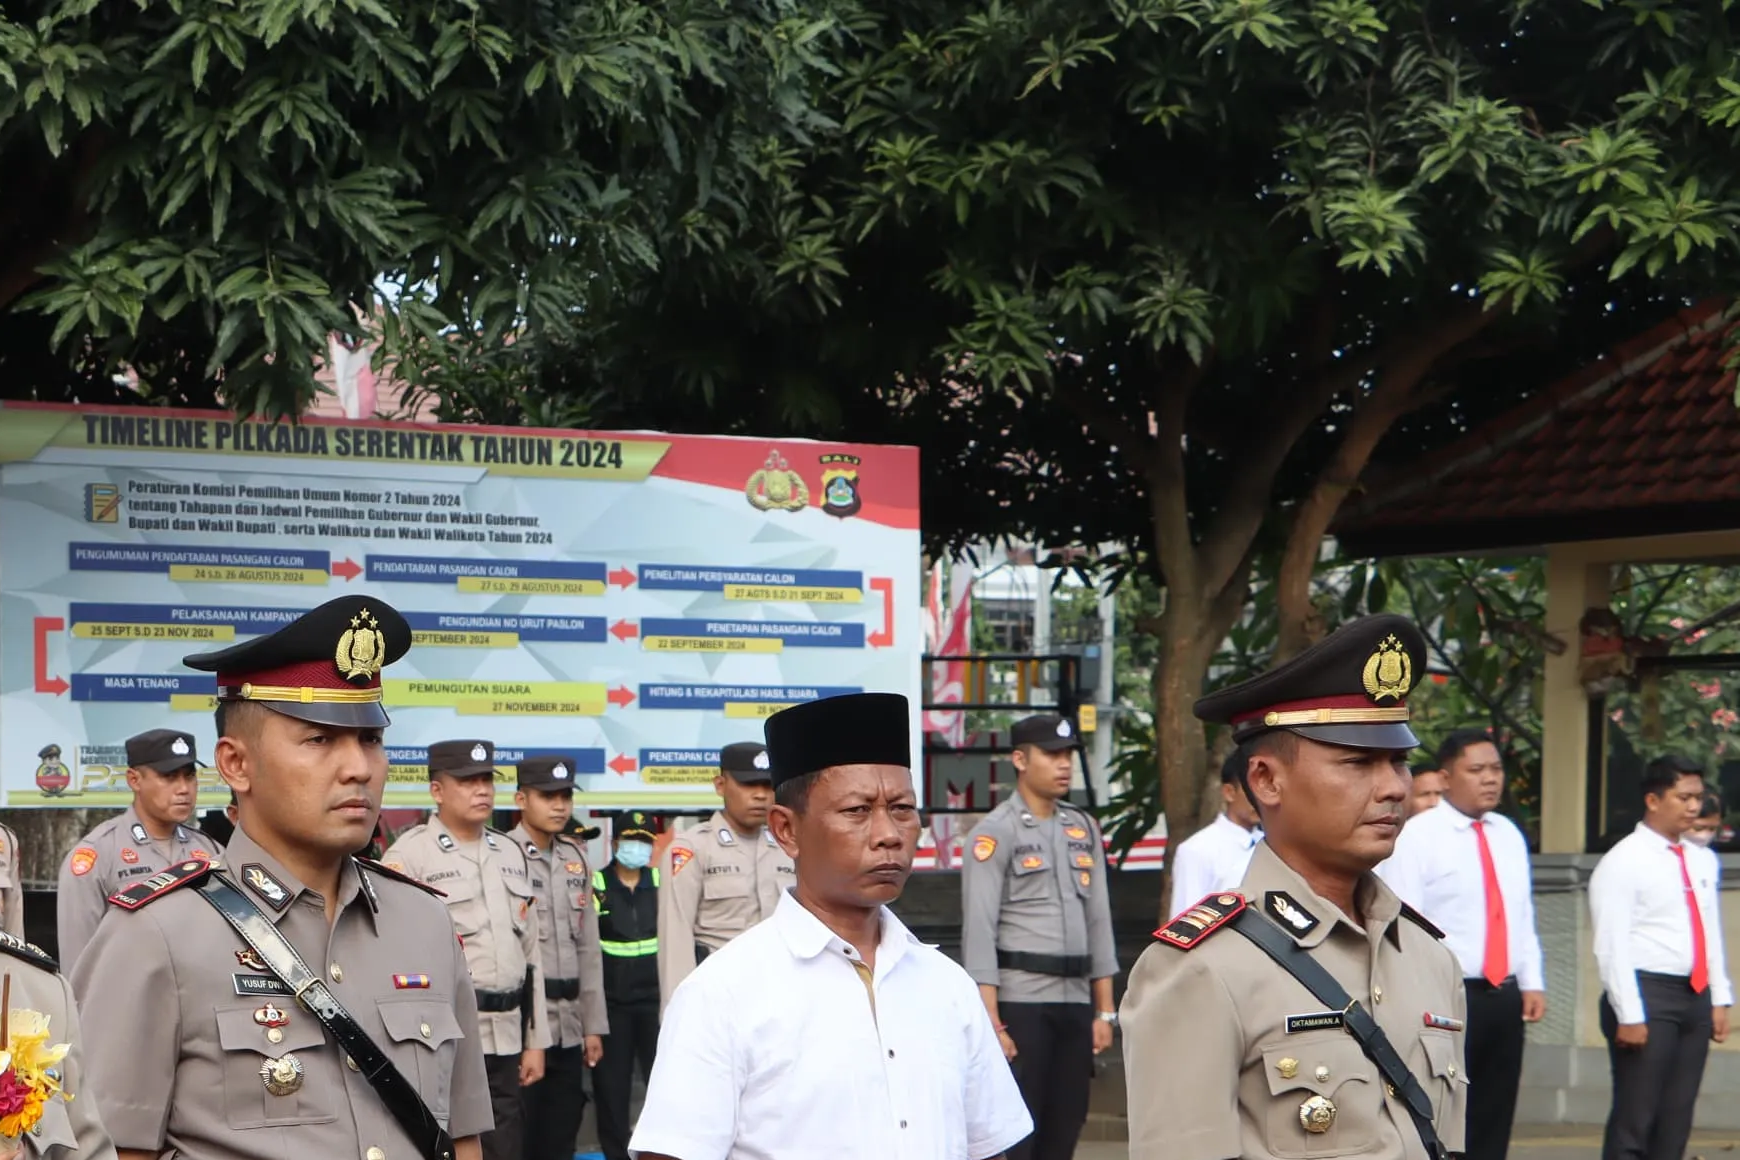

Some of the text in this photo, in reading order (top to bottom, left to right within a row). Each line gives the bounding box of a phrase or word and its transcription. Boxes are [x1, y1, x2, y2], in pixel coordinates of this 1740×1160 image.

[83, 415, 623, 469] TIMELINE PILKADA SERENTAK TAHUN 2024
[820, 454, 860, 465] BALI
[128, 481, 461, 507] Peraturan Komisi Pemilihan Umum Nomor 2 Tahun 2024
[128, 500, 177, 514] tentang
[180, 501, 233, 516] Tahapan
[235, 503, 258, 516] dan
[261, 504, 302, 518] Jadwal
[304, 506, 365, 520] Pemilihan
[368, 508, 422, 522] Gubernur
[425, 511, 447, 524] dan
[450, 512, 483, 526] Wakil
[128, 517, 169, 531] Bupati
[173, 519, 196, 532] dan
[198, 520, 233, 533] Wakil
[236, 521, 275, 535] Bupati
[284, 523, 315, 536] serta
[318, 525, 371, 539] Walikota
[374, 526, 396, 539] dan
[399, 527, 431, 540] Wakil
[434, 528, 485, 542] Walikota
[489, 530, 523, 544] Tahun
[525, 531, 553, 545] 2024
[76, 549, 304, 566] PENGUMUMAN PENDAFTARAN PASANGAN CALON
[194, 568, 206, 579] 24
[225, 570, 237, 580] 26
[239, 570, 281, 581] AGUSTUS
[283, 572, 304, 582] 2024
[373, 562, 518, 577] PENDAFTARAN PASANGAN CALON
[644, 569, 795, 584] PENELITIAN PERSYARATAN CALON
[480, 581, 491, 591] 27
[522, 582, 561, 593] AGUSTUS
[563, 583, 583, 593] 2024
[801, 590, 823, 600] SEPT
[825, 591, 844, 601] 2024
[171, 609, 247, 621] PELAKSANAAN
[439, 616, 585, 630] PENGUNDIAN NO URUT PASLON
[706, 622, 842, 636] PENETAPAN PASANGAN CALON
[91, 625, 214, 638] 25 SEPT S.D 23 NOV 2024
[469, 635, 490, 645] 2024
[658, 639, 746, 650] 22 SEPTEMBER 2024
[104, 678, 180, 689] MASA TENANG
[409, 683, 531, 695] PEMUNGUTAN SUARA
[649, 687, 684, 698] HITUNG
[694, 688, 758, 699] REKAPITULASI
[760, 690, 786, 699] HASIL
[787, 690, 818, 700] SUARA
[492, 703, 580, 713] 27 NOVEMBER 2024
[649, 751, 703, 762] PENETAPAN
[1161, 929, 1191, 944] POLISI
[242, 979, 266, 989] YUSUF
